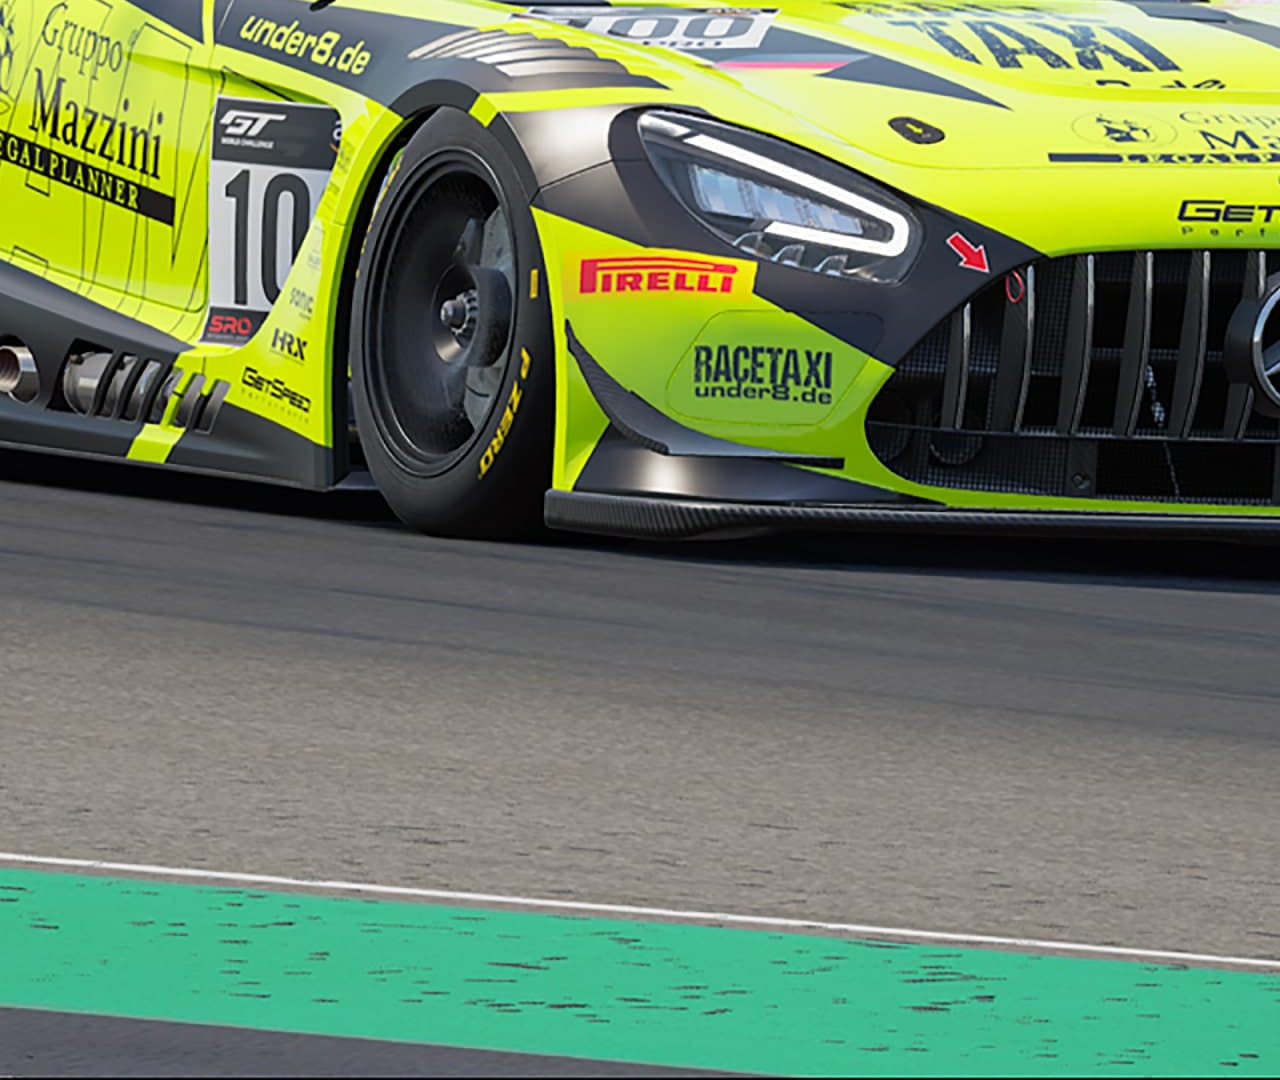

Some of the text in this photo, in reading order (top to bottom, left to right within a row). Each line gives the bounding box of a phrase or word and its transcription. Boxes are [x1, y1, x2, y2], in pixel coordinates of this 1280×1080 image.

[41, 2, 123, 80] Gruppo
[239, 15, 372, 75] under8.de
[886, 20, 1182, 72] TAXI
[28, 67, 165, 180] Mazzini
[219, 109, 288, 137] GT
[579, 256, 738, 294] PIRELLI
[207, 315, 252, 336] SRO
[270, 327, 309, 361] HRX
[693, 344, 833, 390] RACETAXI
[478, 346, 531, 476] P ZERO
[694, 383, 833, 406] under8.de
